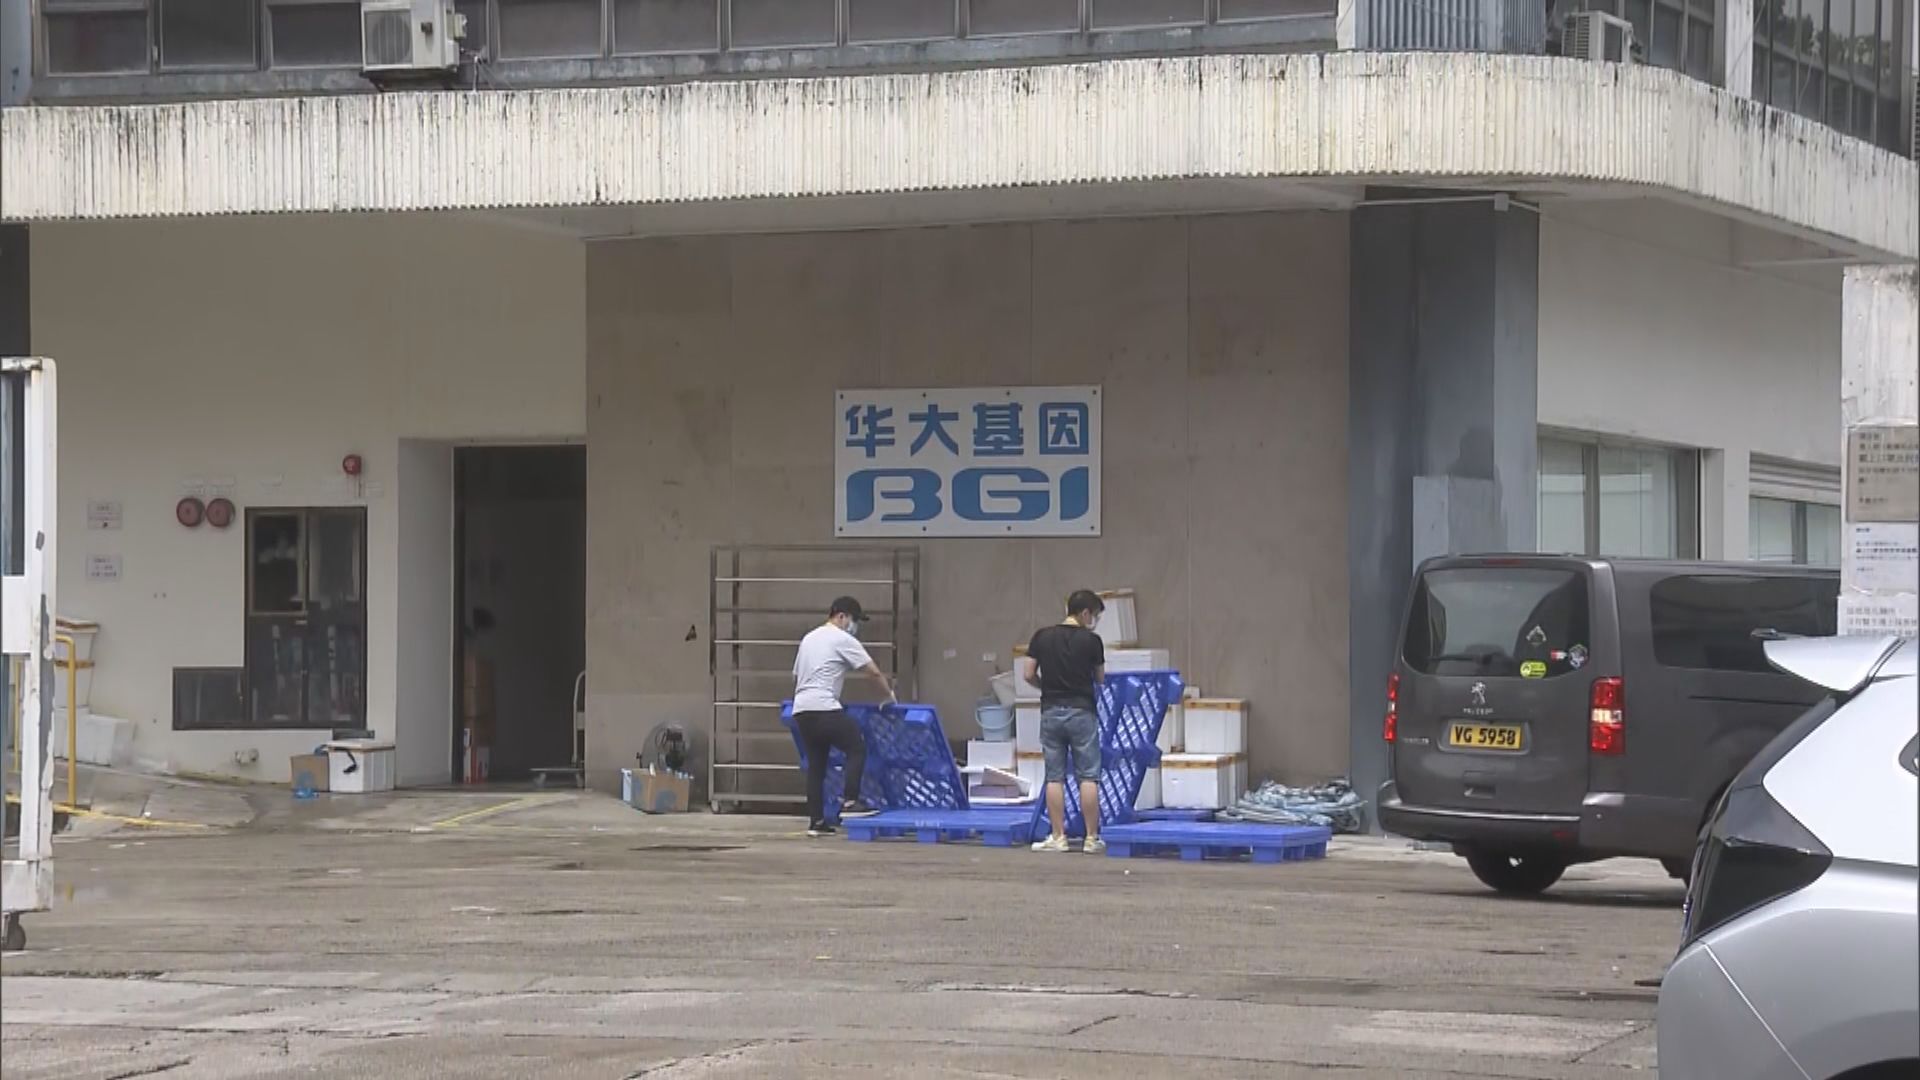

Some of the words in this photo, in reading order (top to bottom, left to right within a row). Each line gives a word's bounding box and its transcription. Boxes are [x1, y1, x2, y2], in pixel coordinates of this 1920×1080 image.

[845, 402, 1089, 458] 华大基因
[846, 466, 1089, 522] BGI
[1455, 725, 1473, 743] VG
[1477, 727, 1516, 745] 5958
